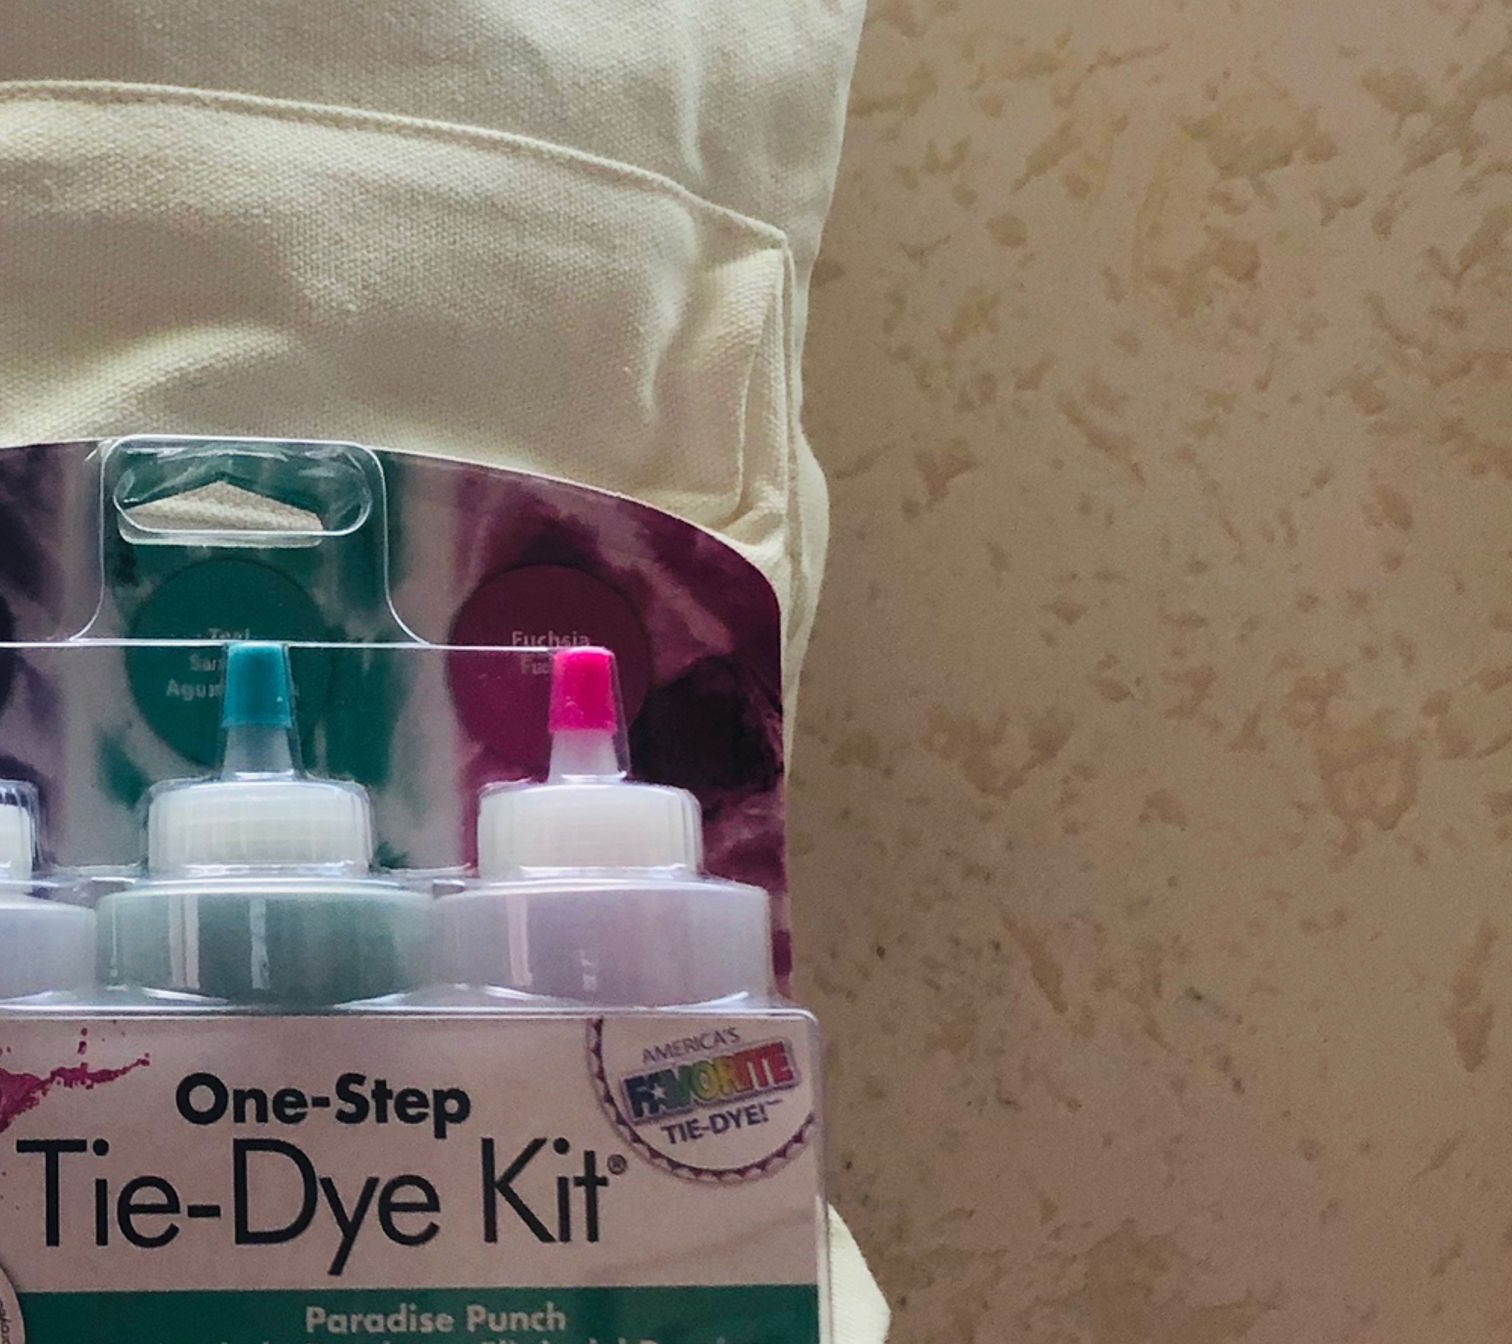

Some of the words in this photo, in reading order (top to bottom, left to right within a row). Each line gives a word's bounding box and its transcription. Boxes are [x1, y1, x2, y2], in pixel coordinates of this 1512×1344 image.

[511, 630, 590, 648] Fuchsia
[642, 1027, 741, 1064] AMERICA'S
[175, 1071, 472, 1140] One-Step
[624, 1040, 795, 1119] FAVORITE
[15, 1137, 442, 1277] Tie-Dye
[305, 1302, 455, 1334] Paradise
[466, 1301, 567, 1332] Punch
